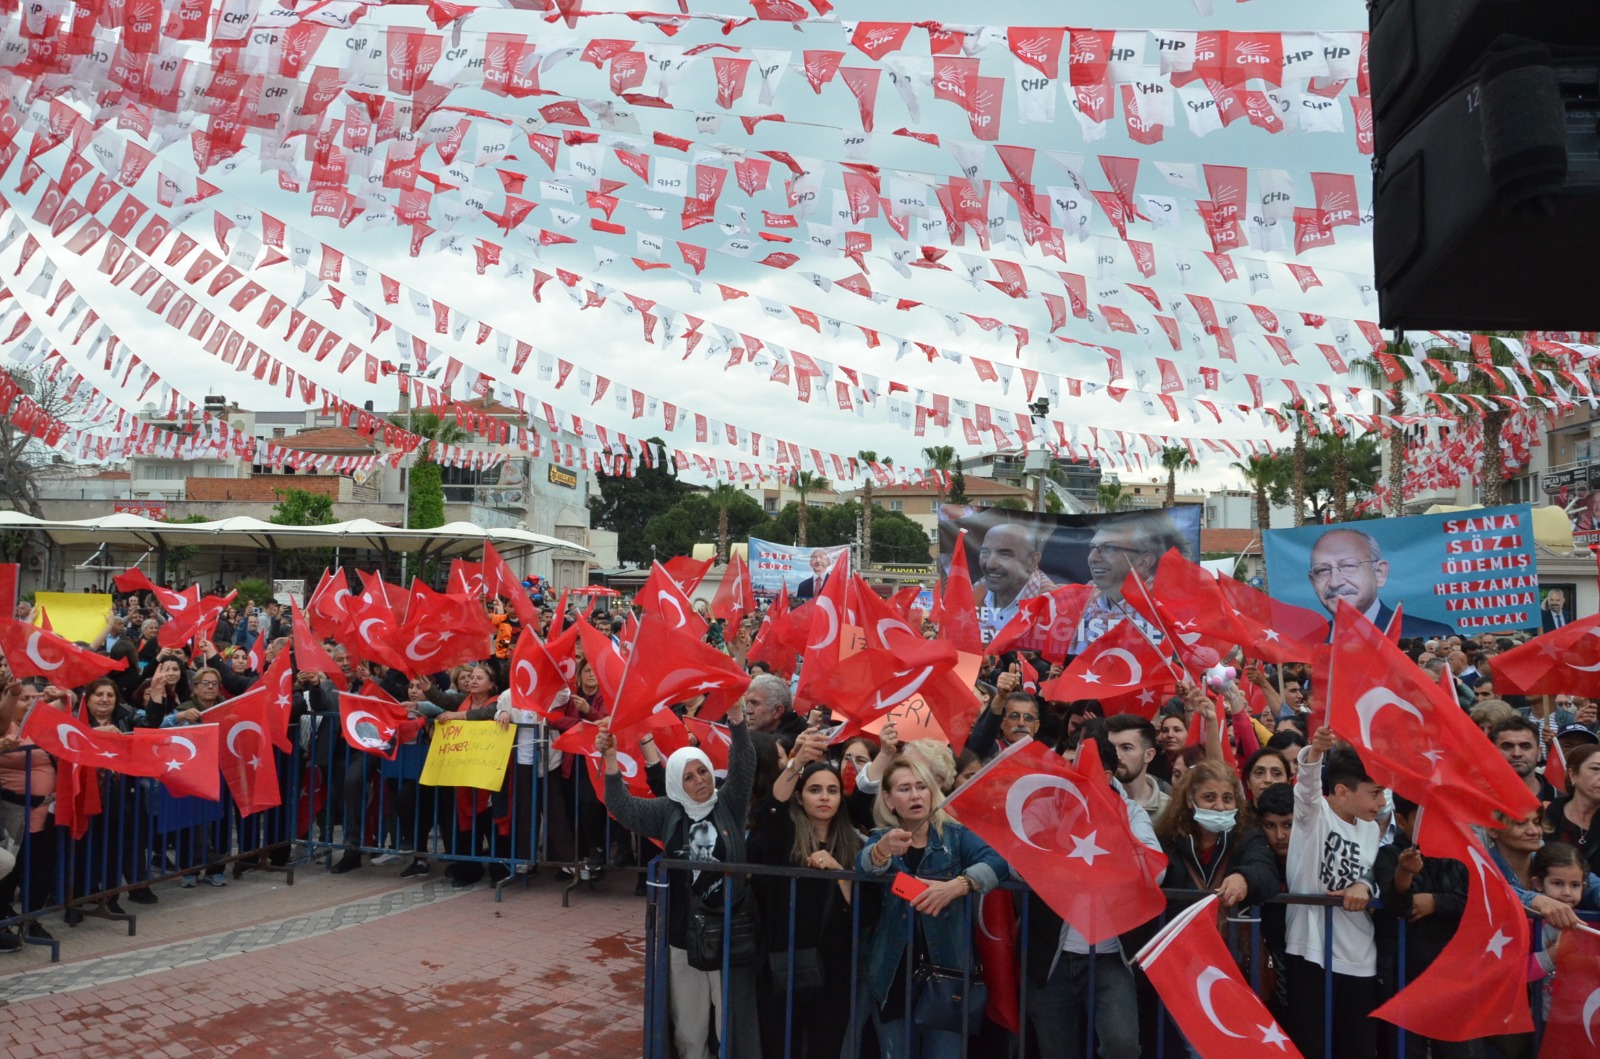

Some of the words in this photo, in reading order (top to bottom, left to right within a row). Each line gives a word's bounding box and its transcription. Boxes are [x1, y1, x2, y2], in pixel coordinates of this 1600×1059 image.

[180, 10, 202, 20] CHP
[224, 12, 249, 23] CHP
[270, 9, 299, 18] CHP
[132, 22, 152, 33] CHP
[864, 37, 894, 50] CHP
[1017, 49, 1047, 62] CHP
[1069, 52, 1095, 65] CHP
[1109, 49, 1135, 62] HP
[1194, 52, 1215, 61] HP
[1236, 54, 1270, 64] CHP
[1280, 50, 1314, 67] CHP
[1324, 47, 1351, 59] HP
[414, 64, 435, 75] CHP
[215, 76, 237, 87] CHP
[513, 75, 533, 88] HP
[1021, 78, 1049, 92] CHP
[1136, 81, 1164, 95] CHP
[265, 87, 288, 98] CHP
[938, 82, 966, 97] CHP
[1079, 94, 1104, 110] CHP
[1302, 99, 1333, 110] CHP
[1467, 86, 1481, 113] 12
[1187, 100, 1215, 113] CHP
[119, 118, 143, 132] CHP
[93, 144, 114, 159] CHP
[352, 144, 373, 156] CHP
[320, 164, 341, 172] CHP
[960, 200, 982, 209] CHP
[1262, 191, 1290, 205] CHP
[313, 205, 336, 213] CHP
[1322, 210, 1352, 225] CHP
[642, 239, 661, 250] CHP
[811, 235, 831, 247] CHP
[766, 306, 782, 314] CHP
[1447, 514, 1515, 535] SANA
[760, 552, 790, 561] SANA
[1447, 552, 1528, 575] ÖDEMİŞ
[1437, 583, 1470, 595] HER
[1478, 573, 1538, 588] ZAMAN
[1448, 591, 1533, 611] YANINDA
[1460, 612, 1524, 628] OLACAK
[441, 725, 464, 740] VPN
